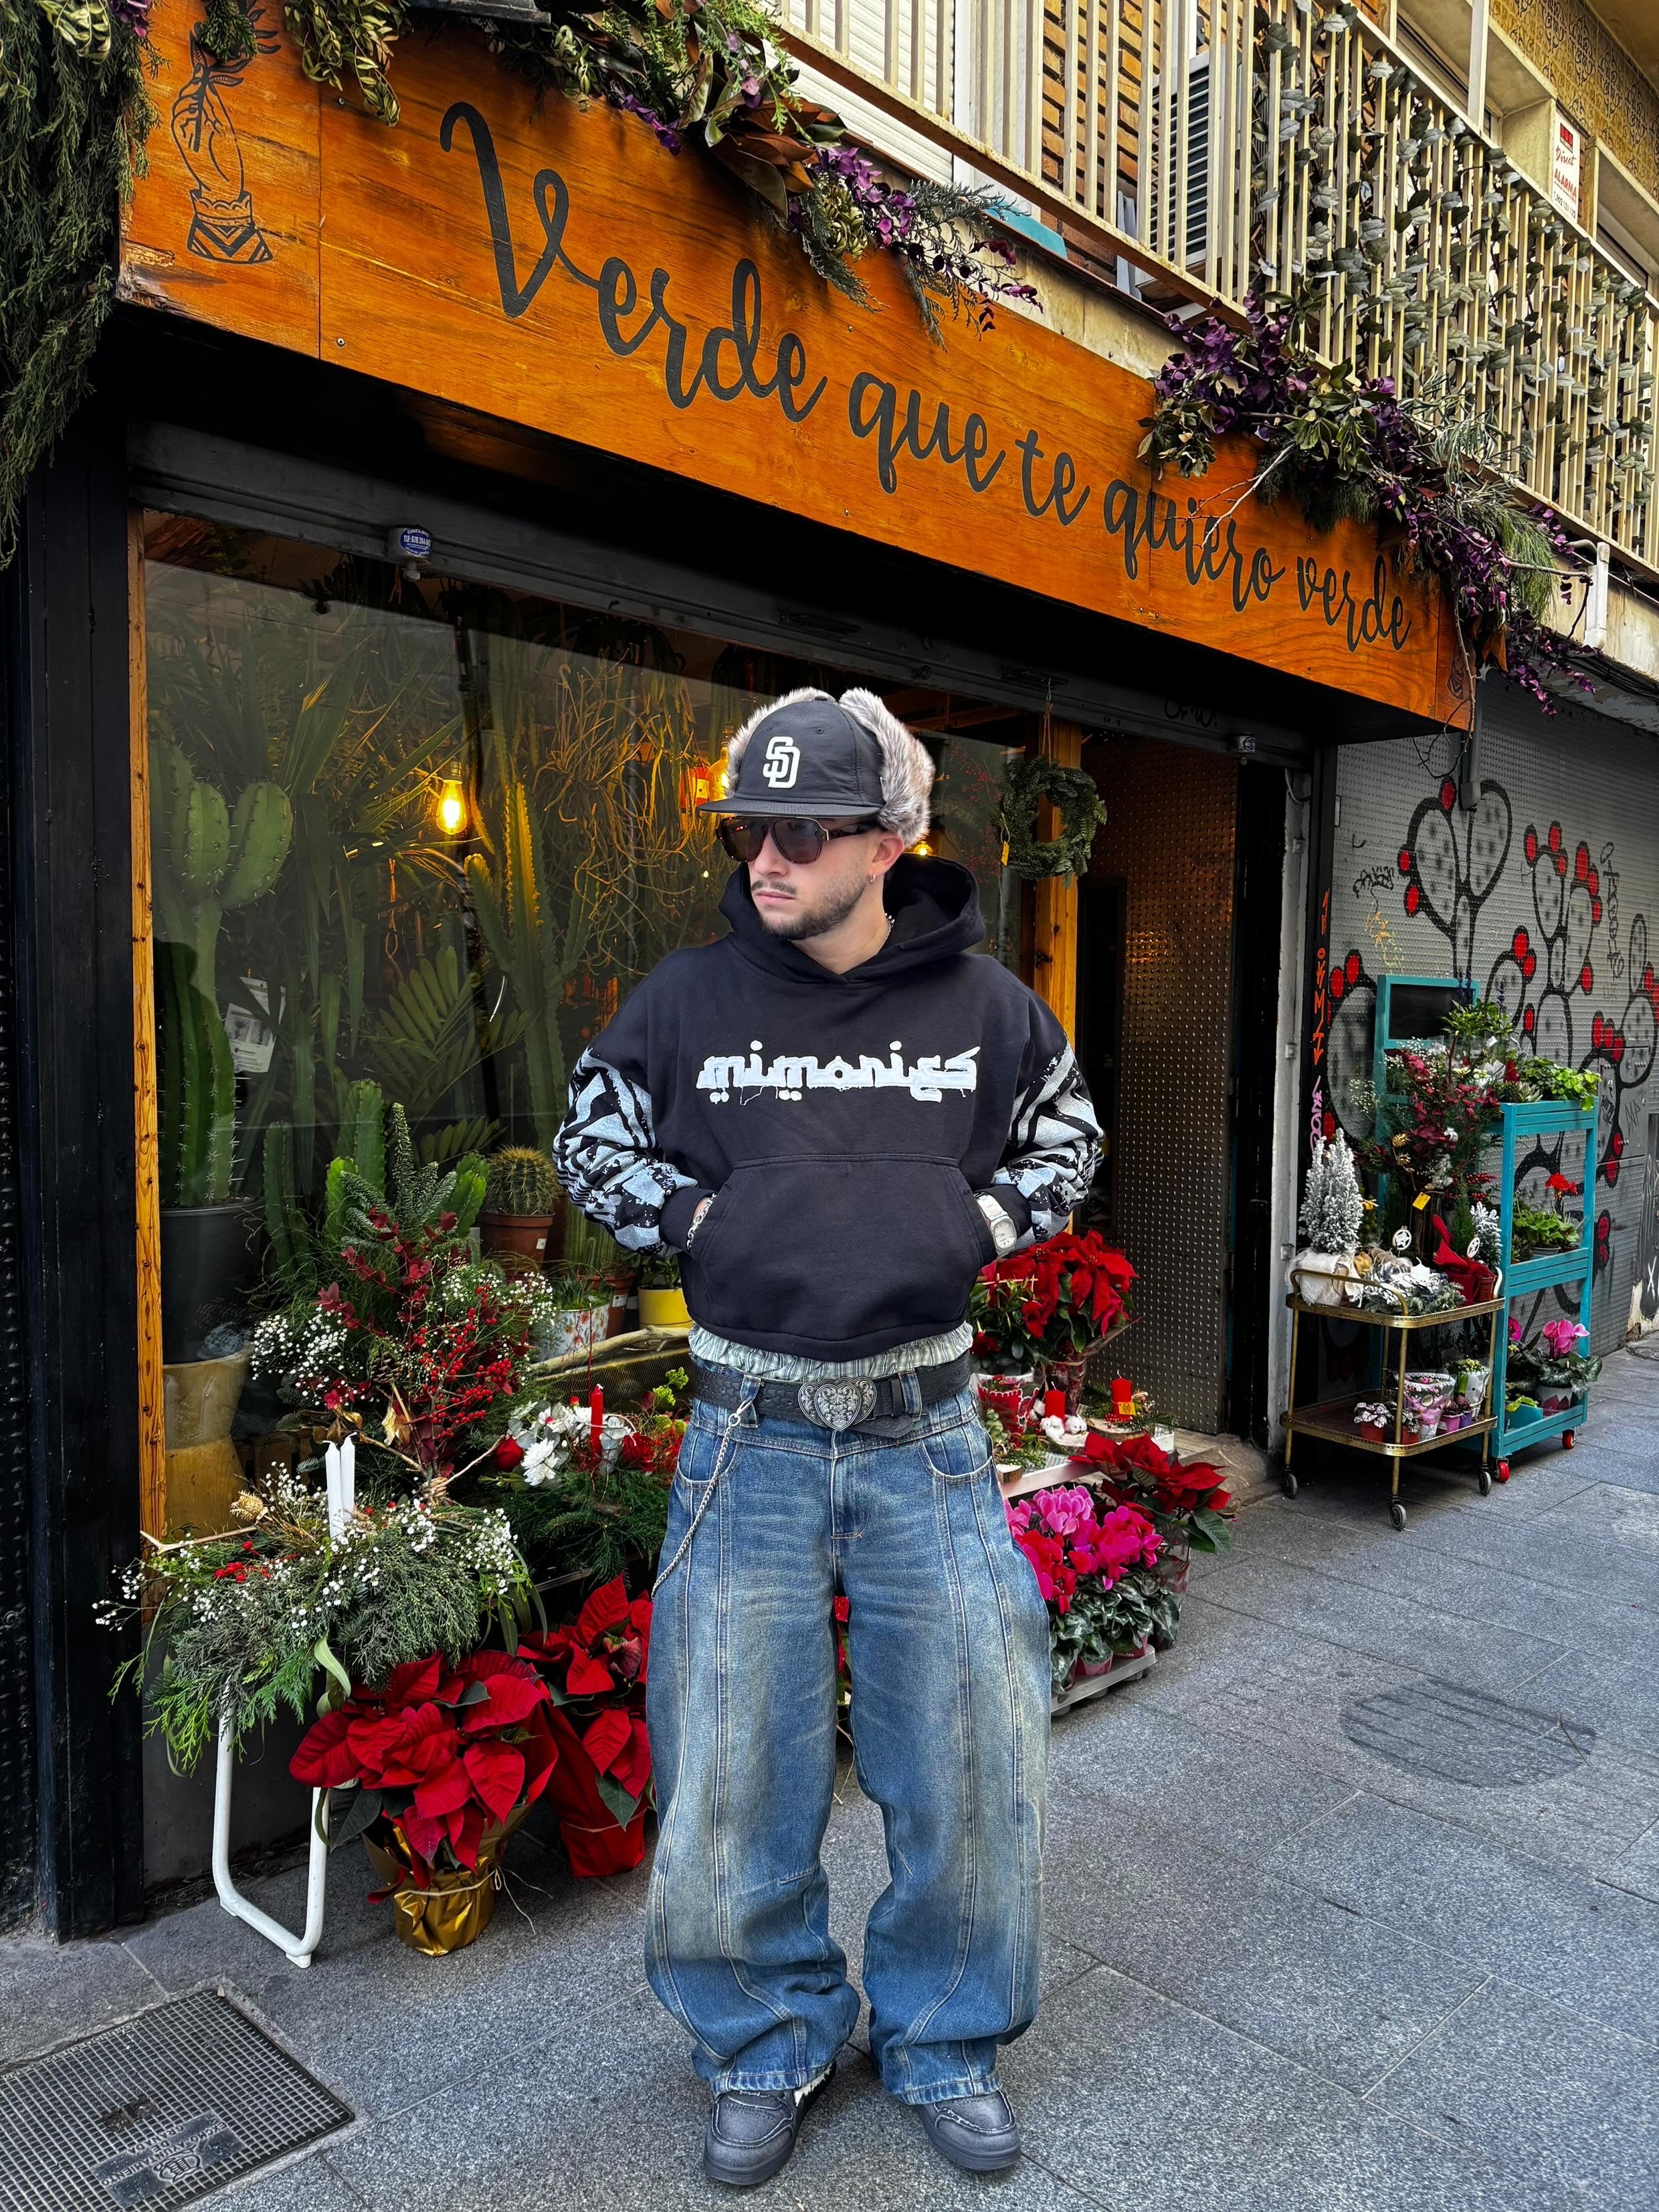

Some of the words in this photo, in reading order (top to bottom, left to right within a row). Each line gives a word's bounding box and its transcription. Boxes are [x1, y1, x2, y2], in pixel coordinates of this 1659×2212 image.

[1555, 144, 1577, 166] Direct
[1554, 168, 1577, 199] ALARMA
[440, 102, 827, 423] Verde
[849, 373, 1005, 494] que
[1015, 429, 1090, 526] te
[1104, 479, 1285, 612] quiero
[1298, 555, 1411, 653] verde
[763, 736, 801, 789] SD
[127, 2124, 184, 2156] GRANADA
[151, 2140, 170, 2152] DE
[101, 2141, 186, 2187] AYUNTAMIENTO
